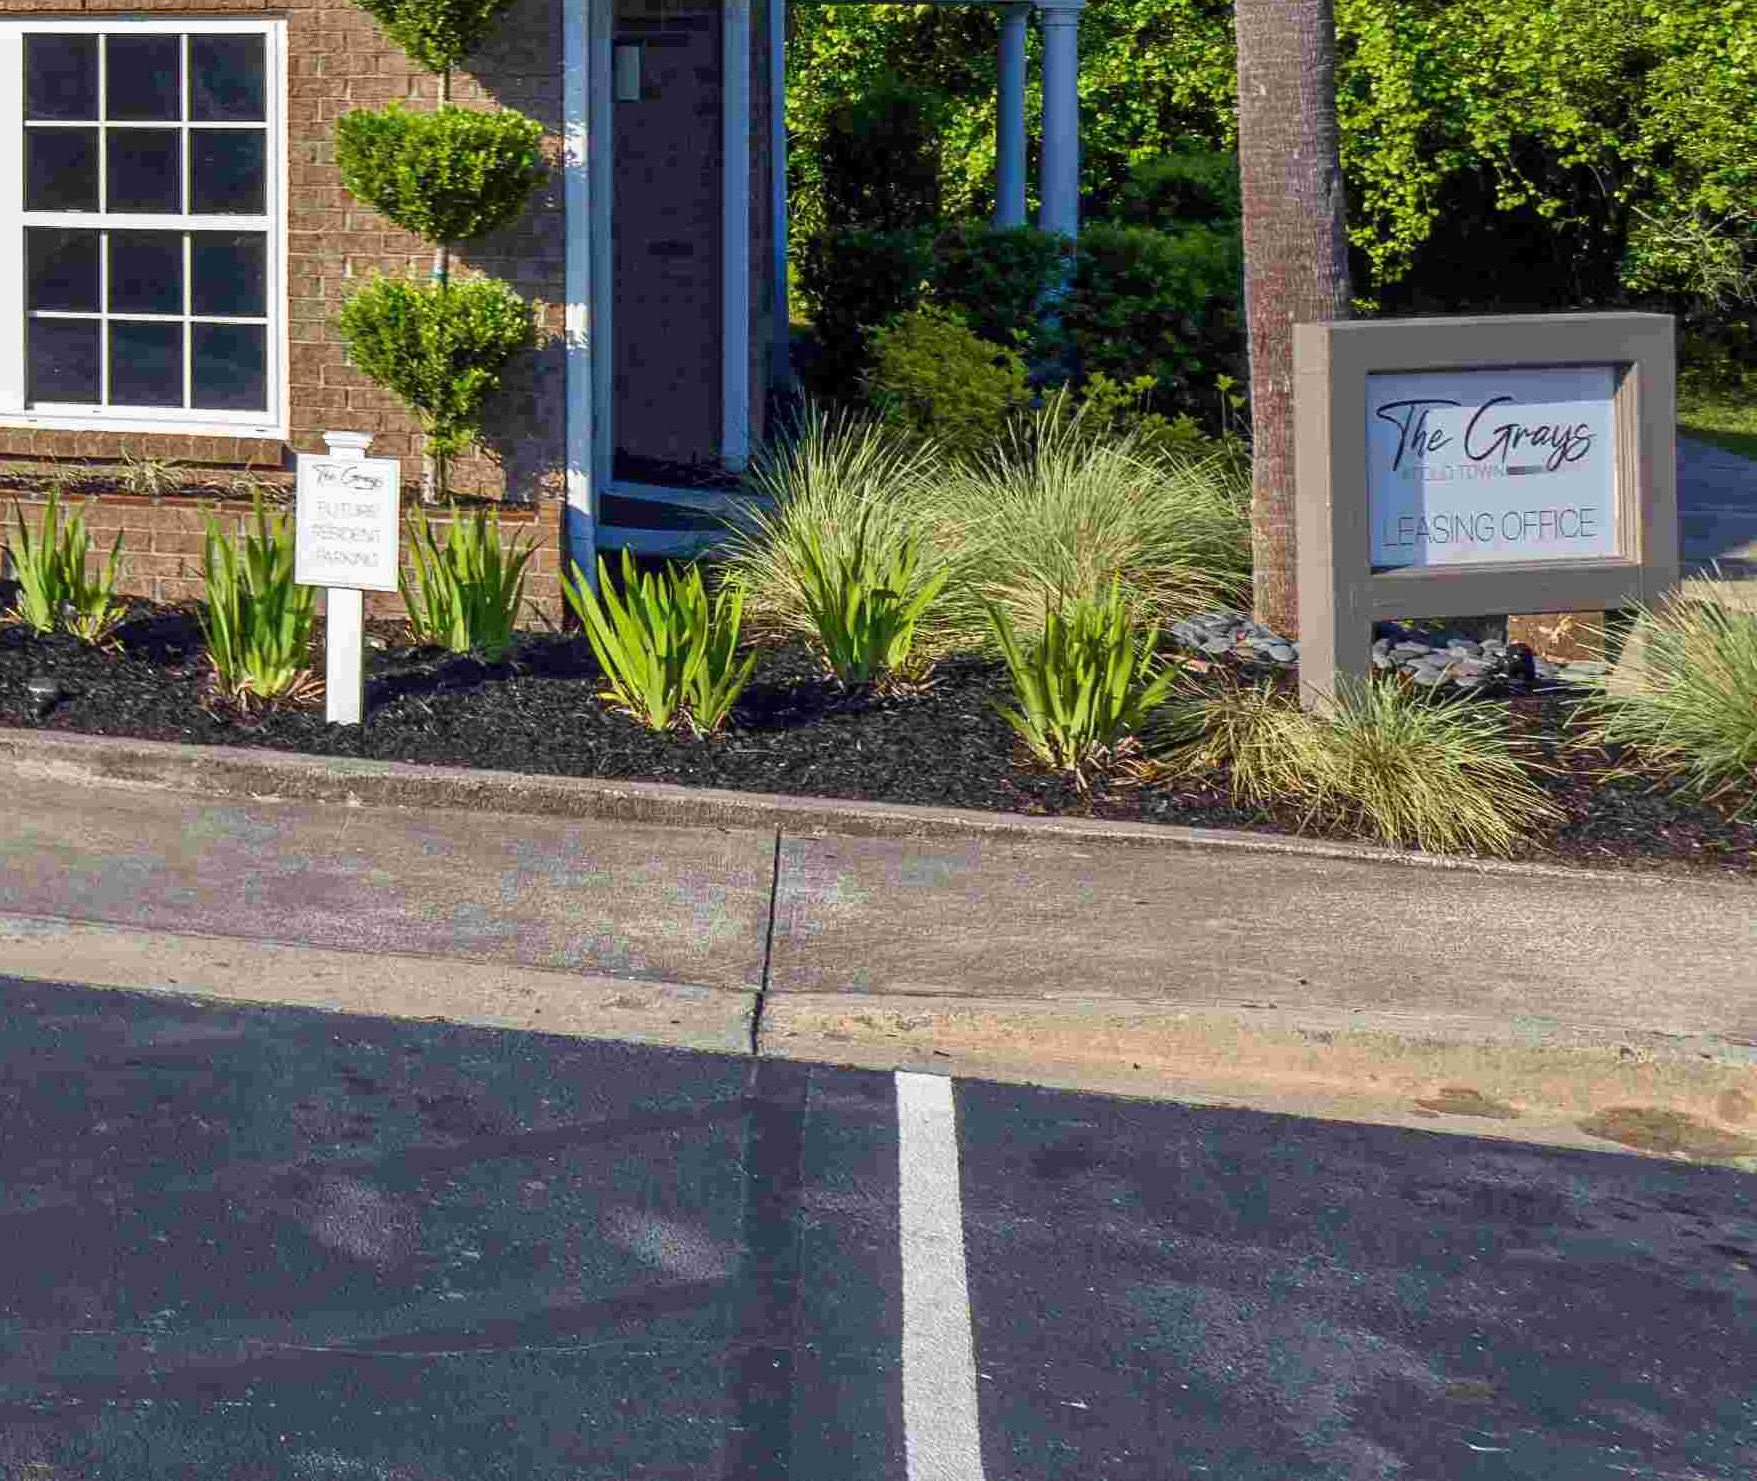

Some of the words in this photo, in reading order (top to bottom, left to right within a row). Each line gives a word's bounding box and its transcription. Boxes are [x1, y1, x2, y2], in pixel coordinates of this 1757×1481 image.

[1375, 398, 1462, 472] The
[1463, 395, 1598, 471] Grays
[1381, 512, 1495, 547] LEASING
[1500, 507, 1598, 542] OFFICE
